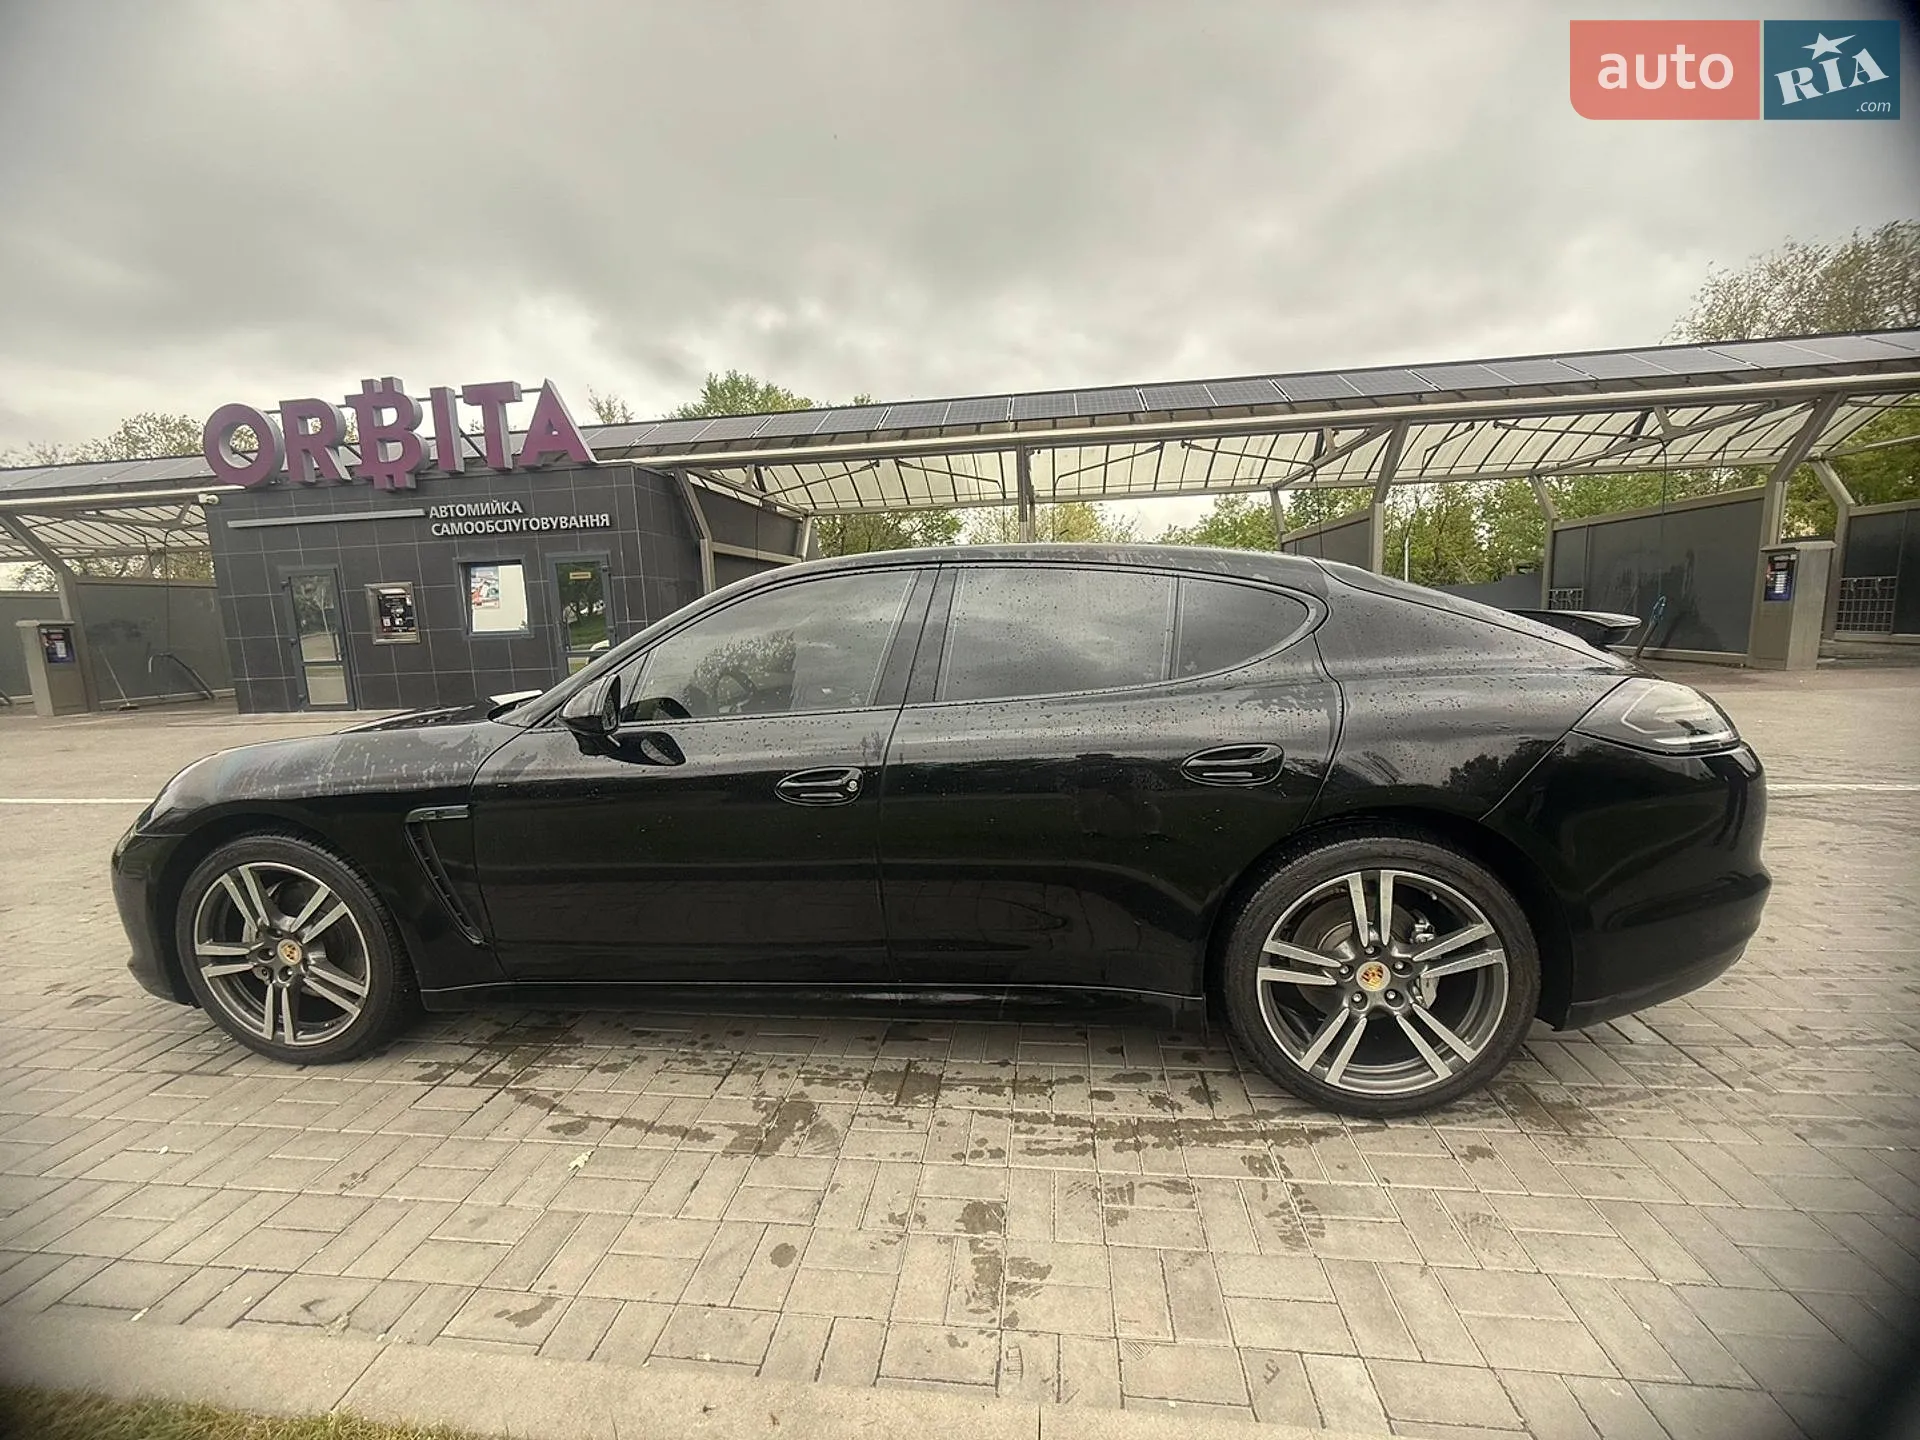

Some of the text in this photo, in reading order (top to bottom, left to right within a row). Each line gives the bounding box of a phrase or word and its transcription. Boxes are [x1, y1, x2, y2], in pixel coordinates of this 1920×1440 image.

[203, 376, 598, 491] ORBITA
[429, 500, 524, 519] АВТОМИЙКА
[431, 513, 611, 537] САМООБСЛУГОВУВАННЯ
